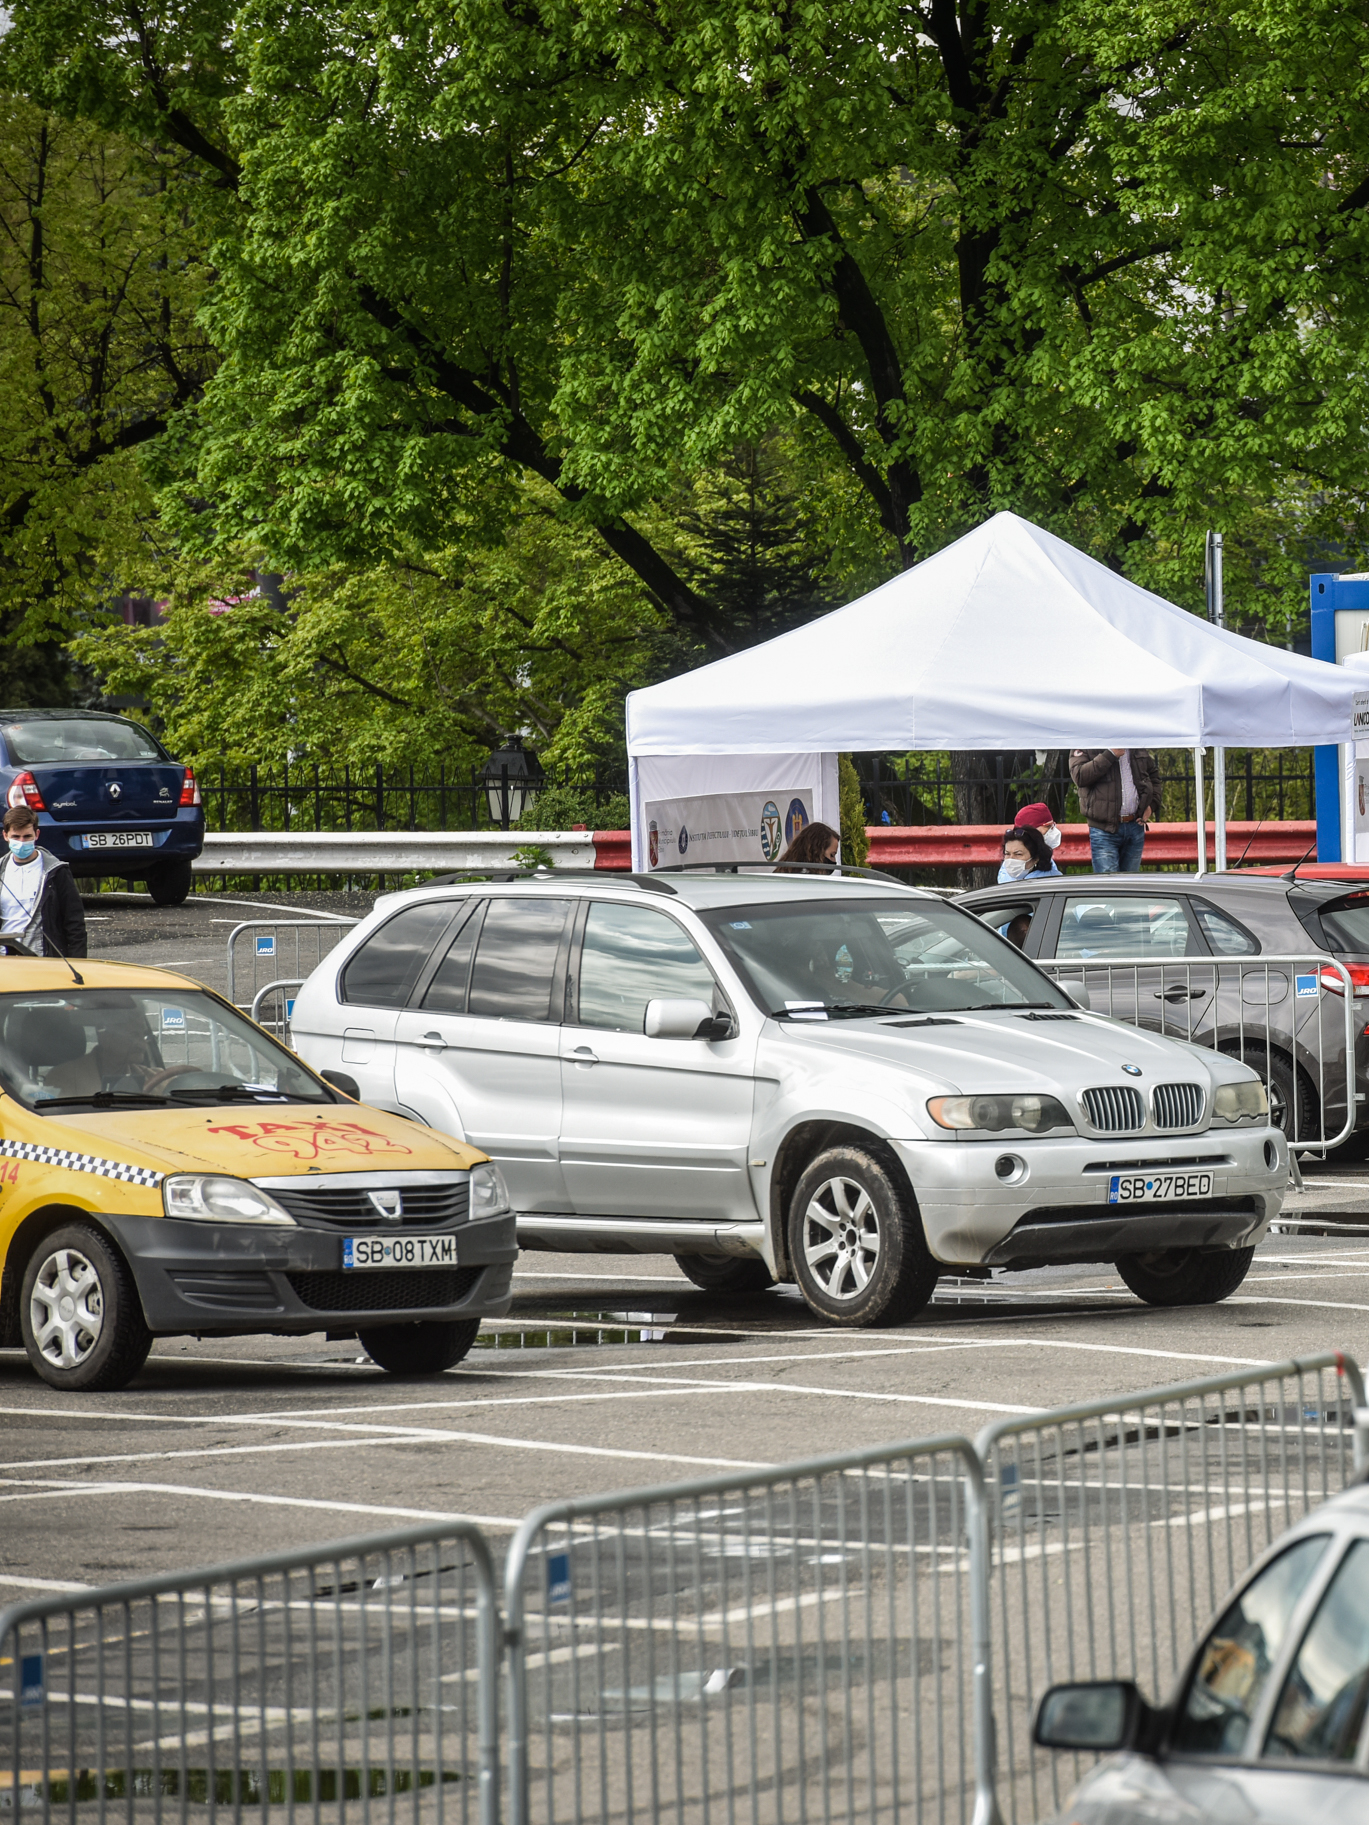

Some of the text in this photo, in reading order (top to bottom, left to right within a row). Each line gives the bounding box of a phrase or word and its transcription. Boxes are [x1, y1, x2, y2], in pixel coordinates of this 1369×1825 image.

[1298, 987, 1317, 995] JRO
[207, 1121, 388, 1140] TAXI
[252, 1131, 413, 1160] 942
[1120, 1178, 1146, 1200] SB
[356, 1240, 384, 1264] SB
